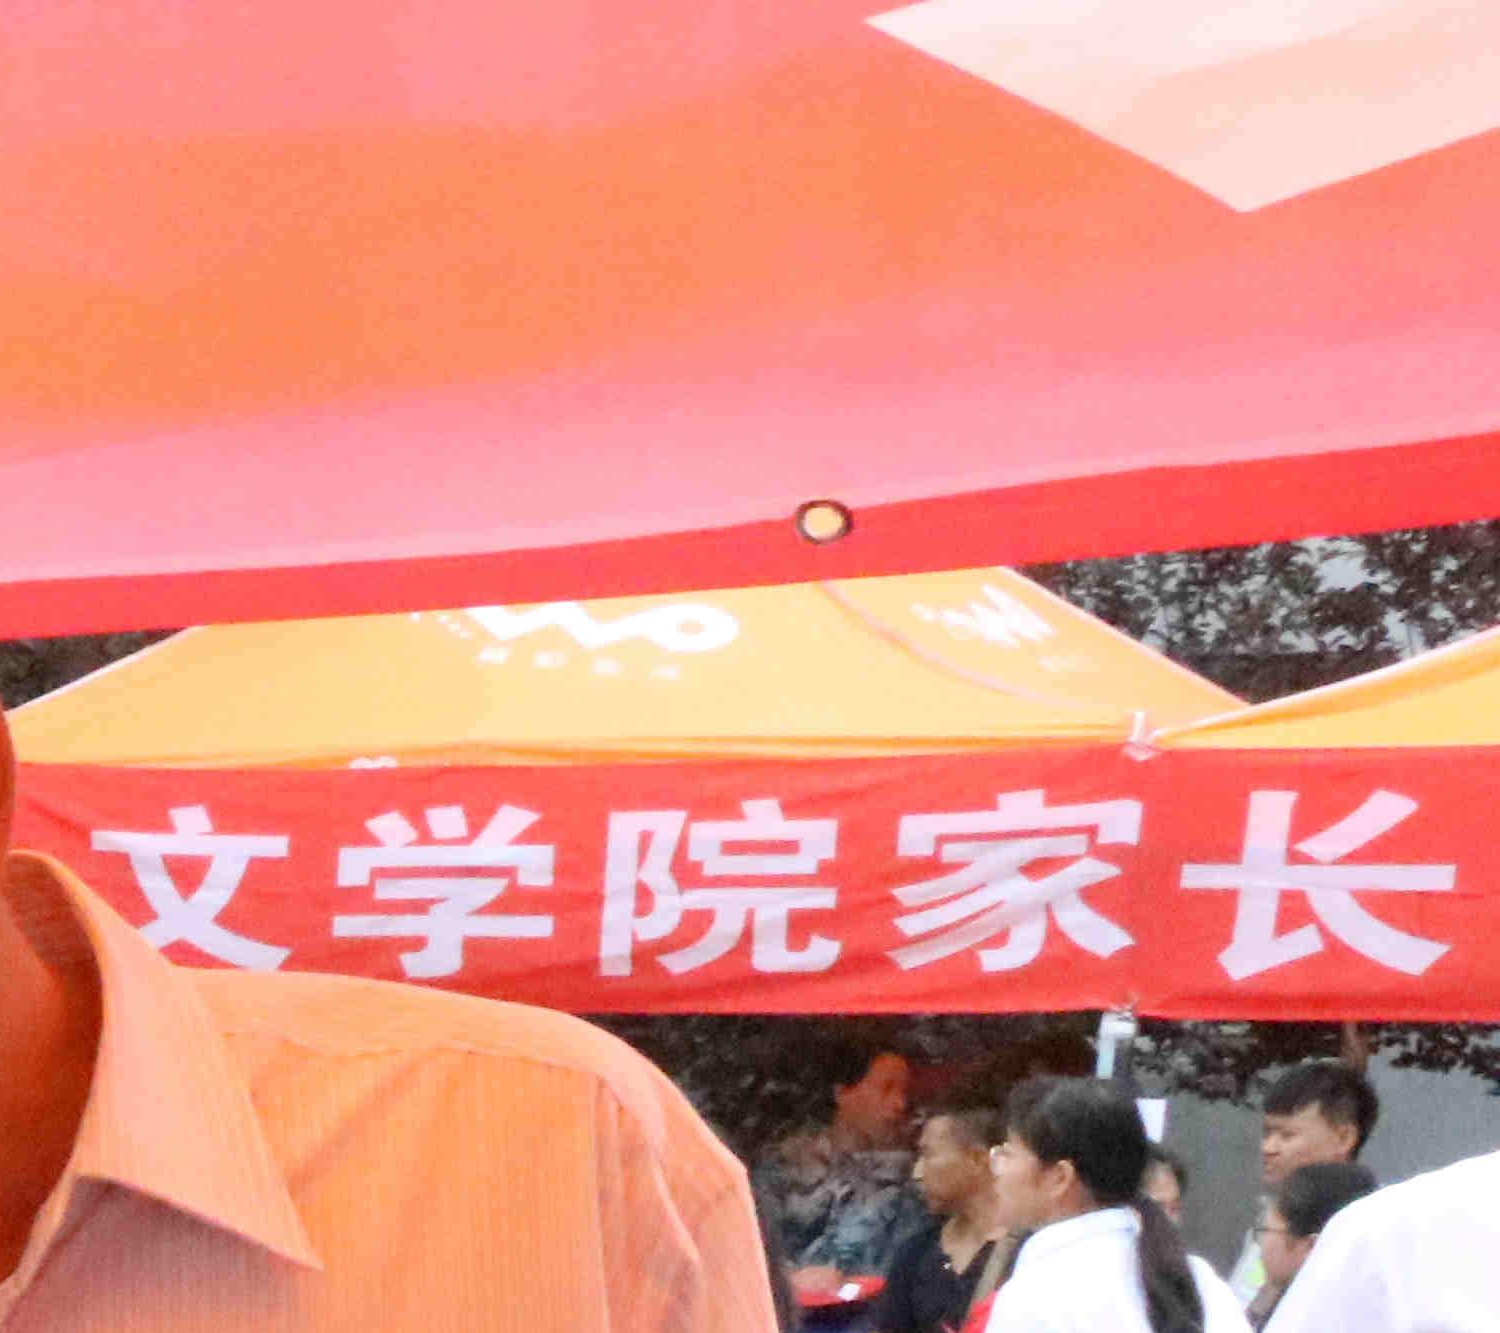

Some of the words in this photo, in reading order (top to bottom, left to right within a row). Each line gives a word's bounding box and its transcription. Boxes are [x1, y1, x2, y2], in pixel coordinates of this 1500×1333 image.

[88, 786, 1460, 984] 文学院家长
